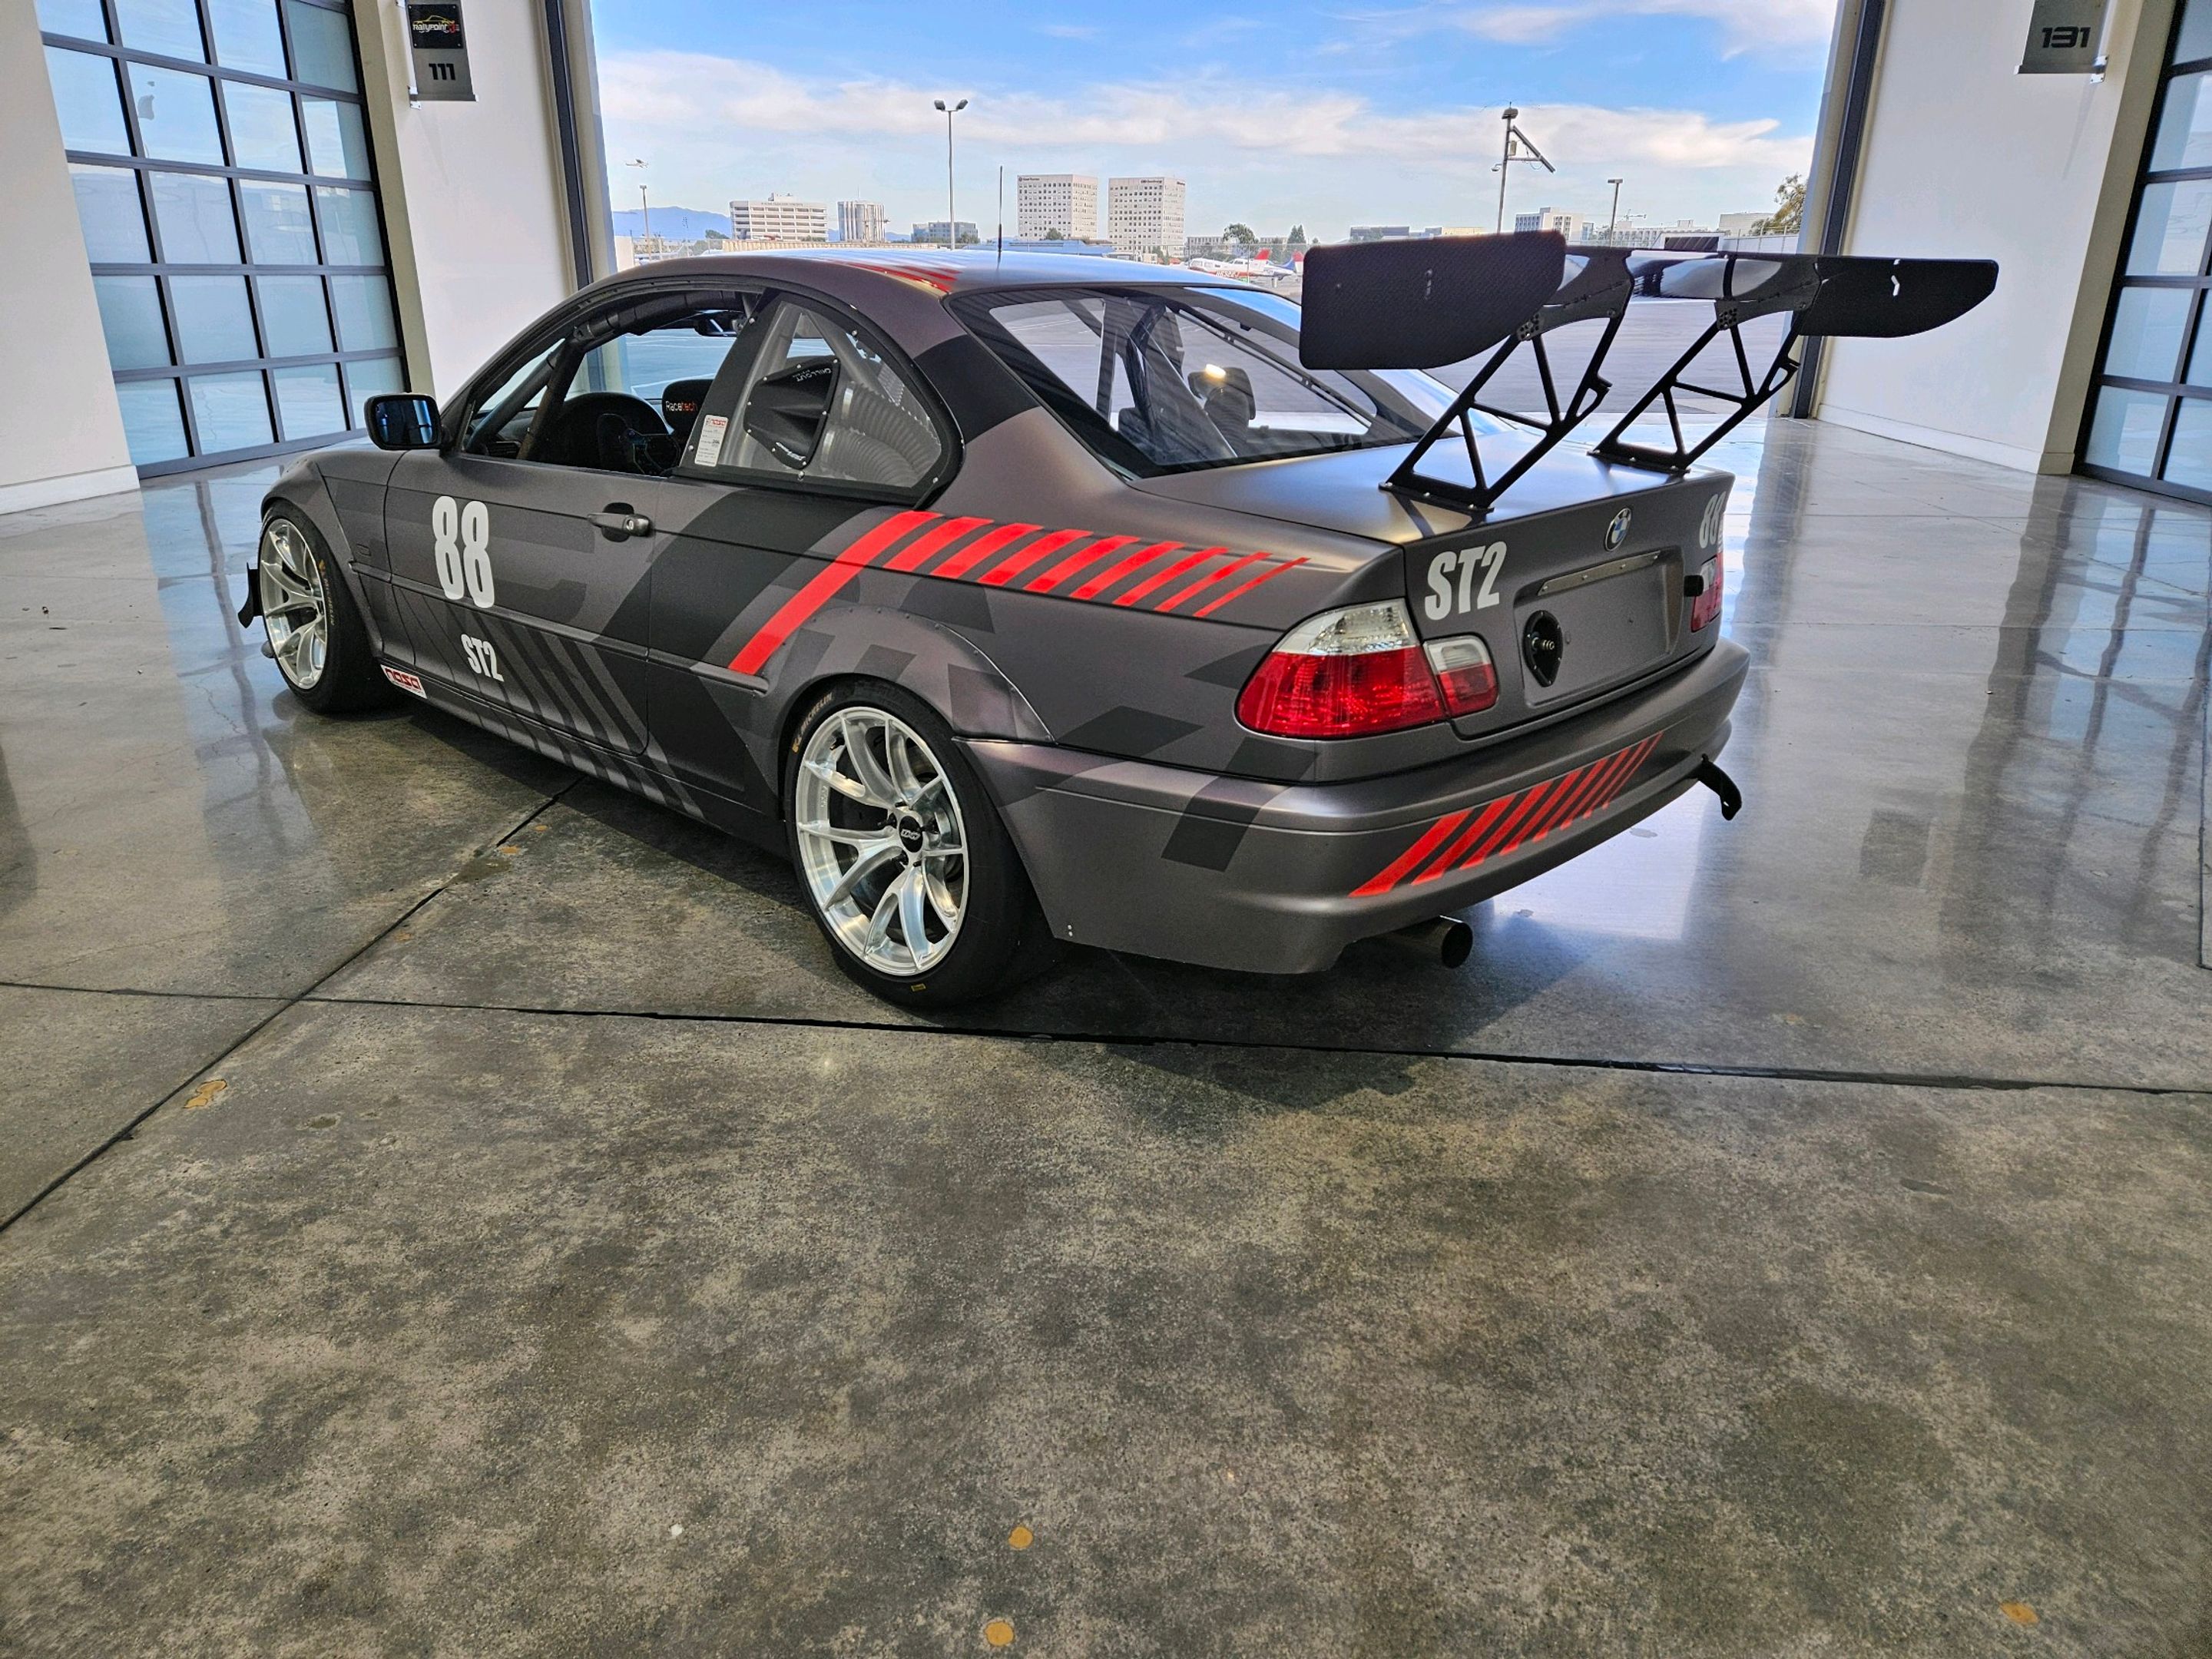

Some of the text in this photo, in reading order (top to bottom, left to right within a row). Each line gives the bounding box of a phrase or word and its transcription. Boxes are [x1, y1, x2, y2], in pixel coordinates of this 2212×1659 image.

[2041, 26, 2091, 48] 131
[429, 63, 455, 80] 111
[796, 368, 831, 382] CHILLOUT
[665, 400, 698, 412] Racetech
[1699, 492, 1727, 548] 88
[432, 495, 495, 608] 88
[1425, 541, 1507, 621] ST2
[461, 634, 505, 682] ST2
[800, 692, 833, 735] MICHELIN
